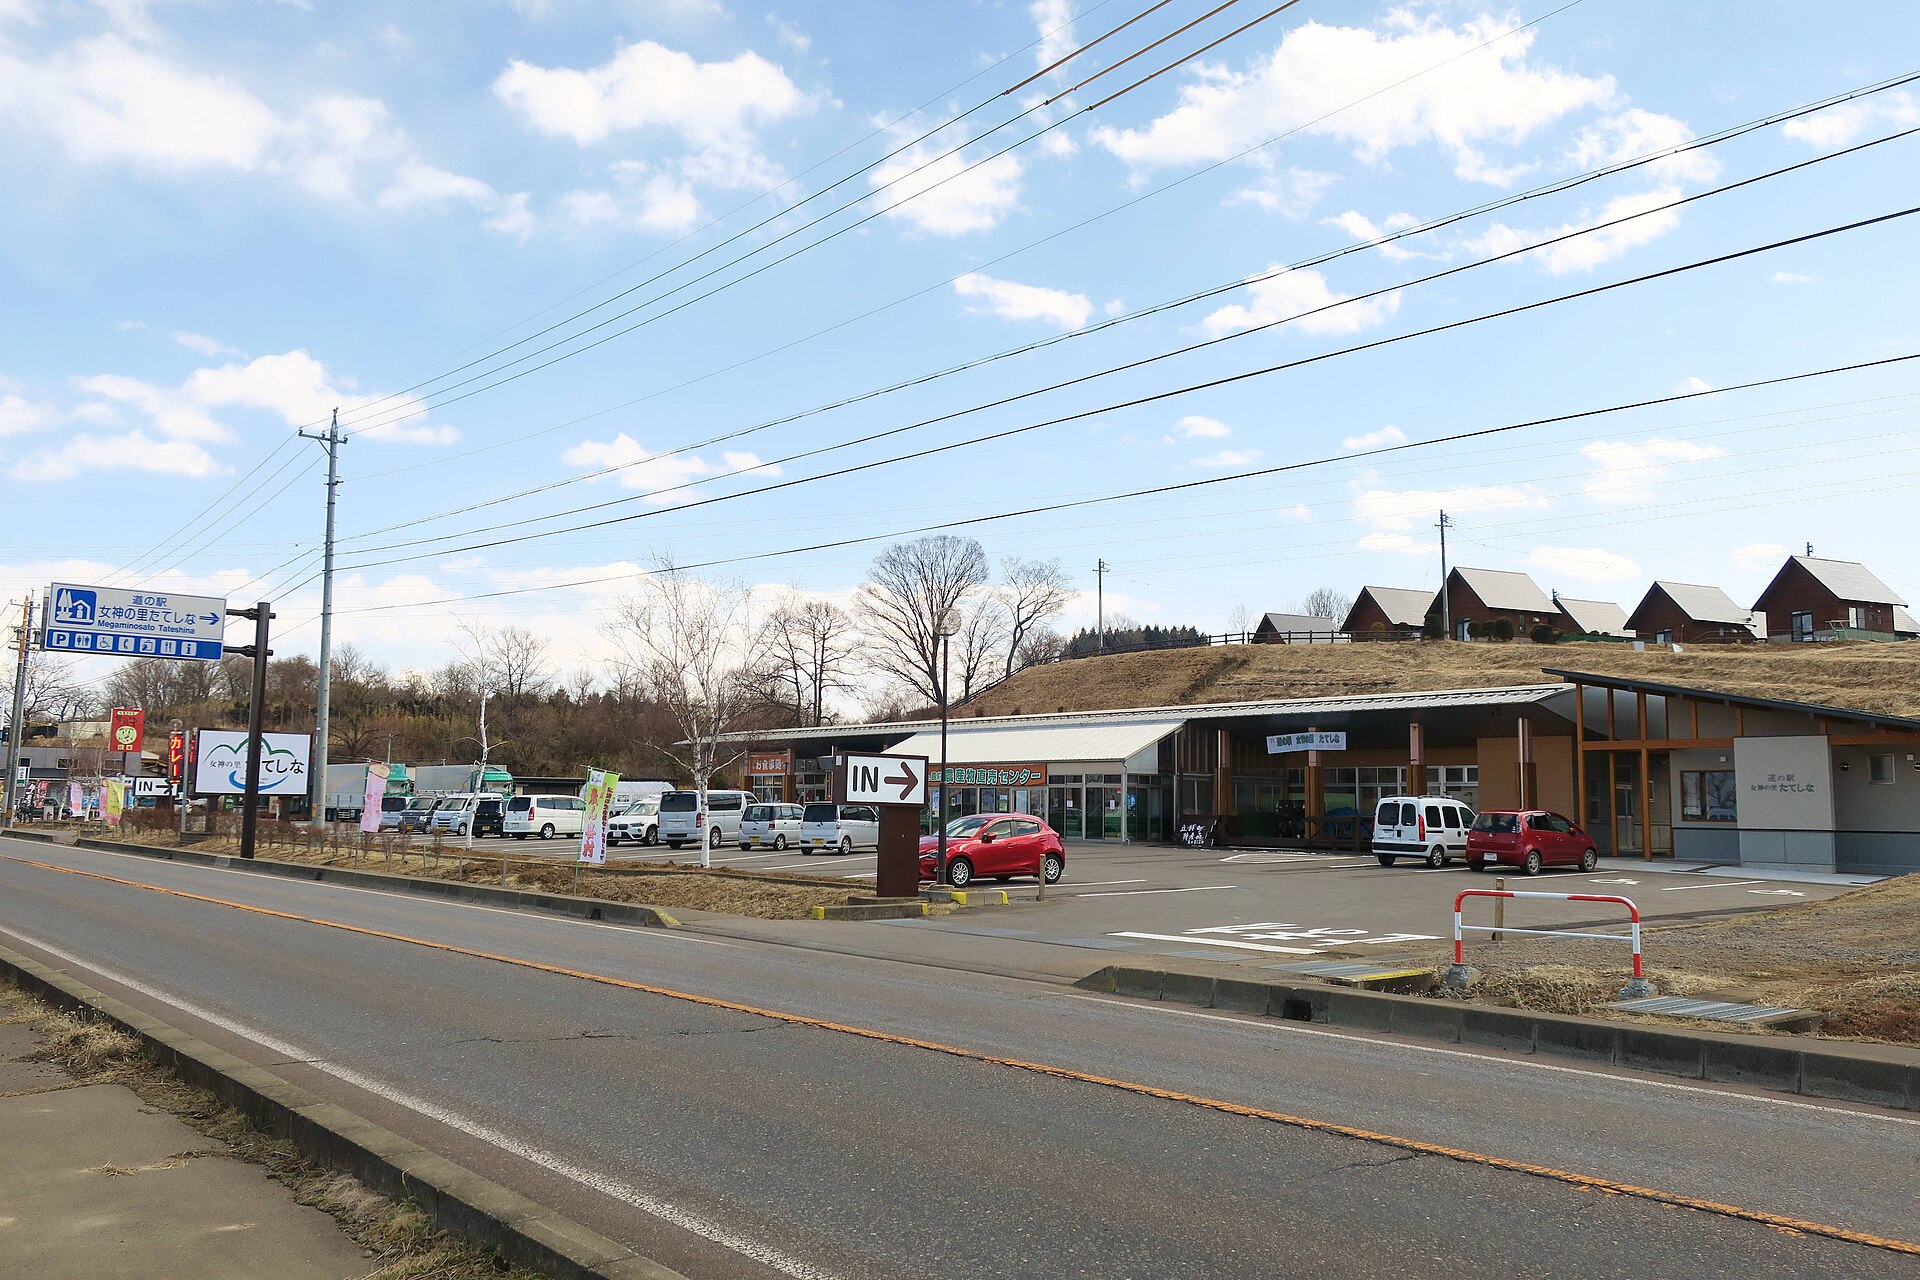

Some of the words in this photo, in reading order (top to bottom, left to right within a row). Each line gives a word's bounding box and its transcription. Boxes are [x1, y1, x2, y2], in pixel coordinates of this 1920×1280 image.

[132, 595, 167, 607] 道の駅
[98, 605, 196, 625] 女神の里たてしな
[97, 619, 156, 631] Megaminosato
[159, 624, 195, 635] Tateshina
[170, 736, 182, 777] カレー
[209, 760, 241, 769] 女神の里
[852, 765, 879, 793] IN
[945, 767, 1041, 786] 農産物直売センター
[1767, 773, 1796, 783] 道の駅
[138, 781, 153, 792] IN
[1779, 783, 1815, 793] たてしな
